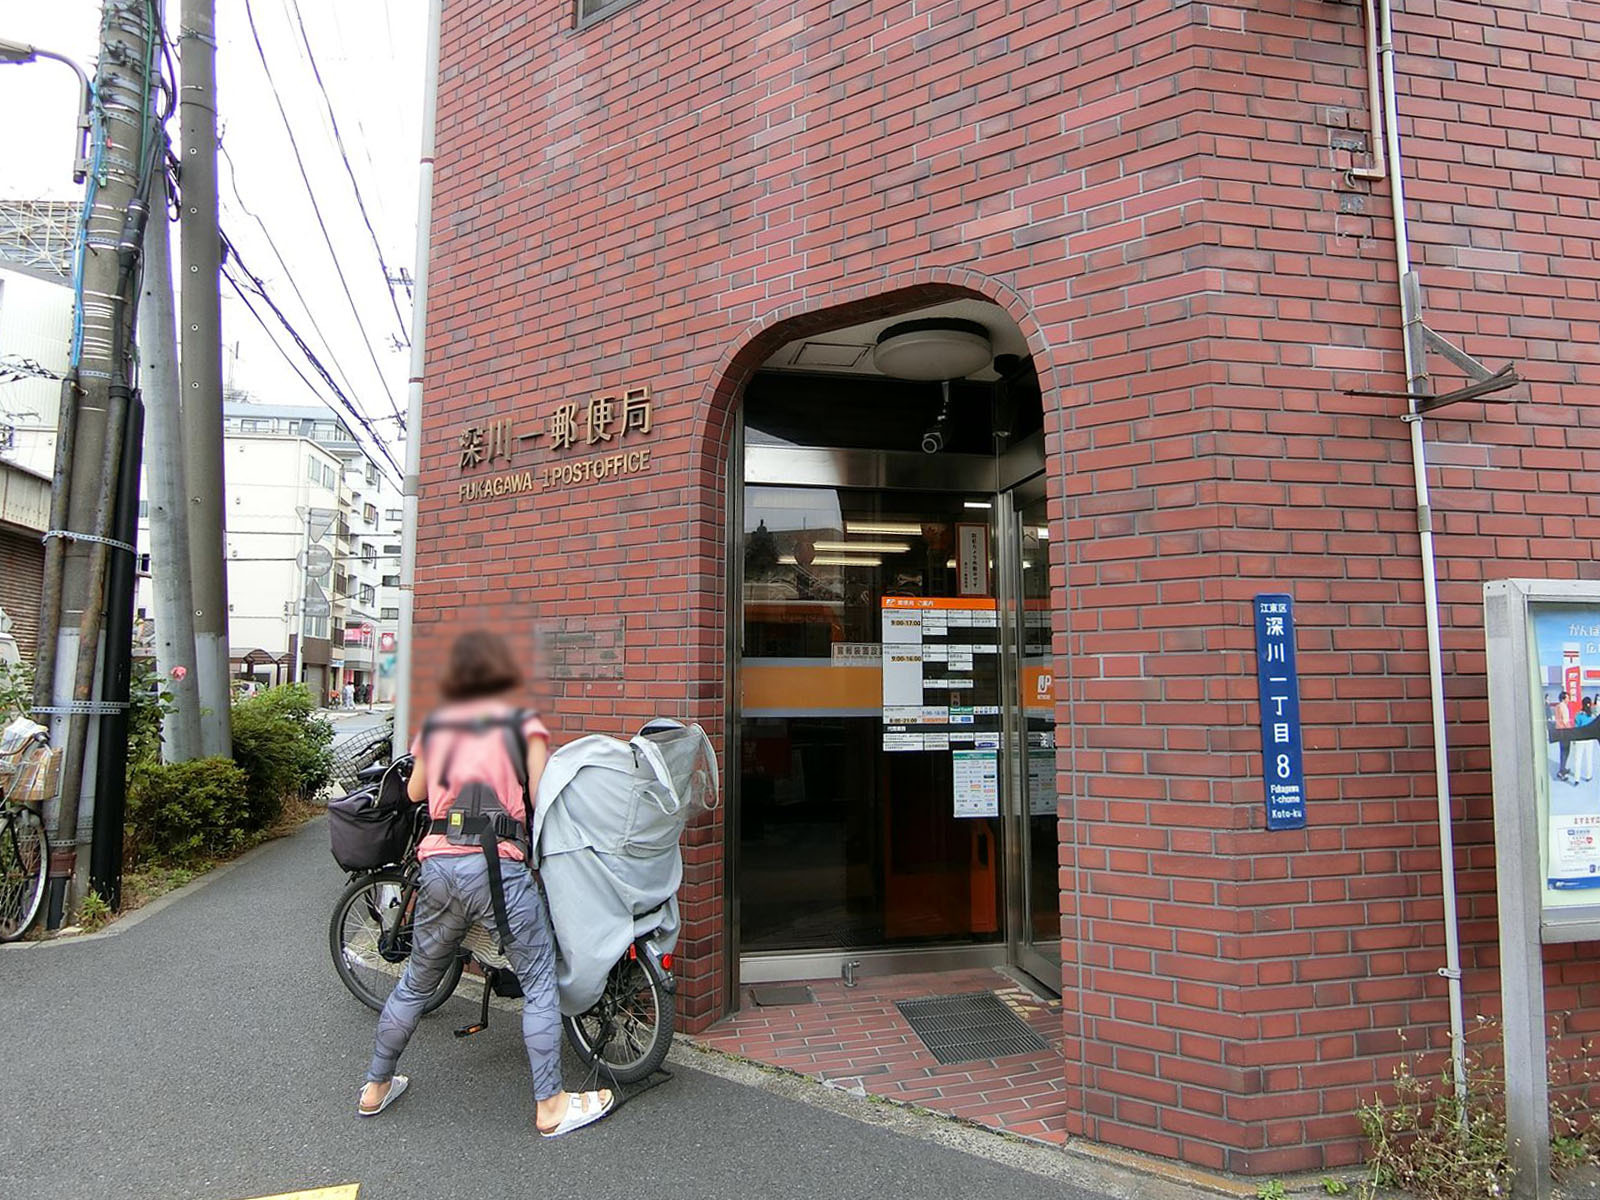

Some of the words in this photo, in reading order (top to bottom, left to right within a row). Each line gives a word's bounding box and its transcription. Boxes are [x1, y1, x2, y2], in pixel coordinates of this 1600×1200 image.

[458, 386, 652, 470] 深川一郵便局
[459, 471, 533, 502] FUKAGAWA
[1260, 603, 1287, 613] 江東区
[837, 646, 882, 656] 警報装置設
